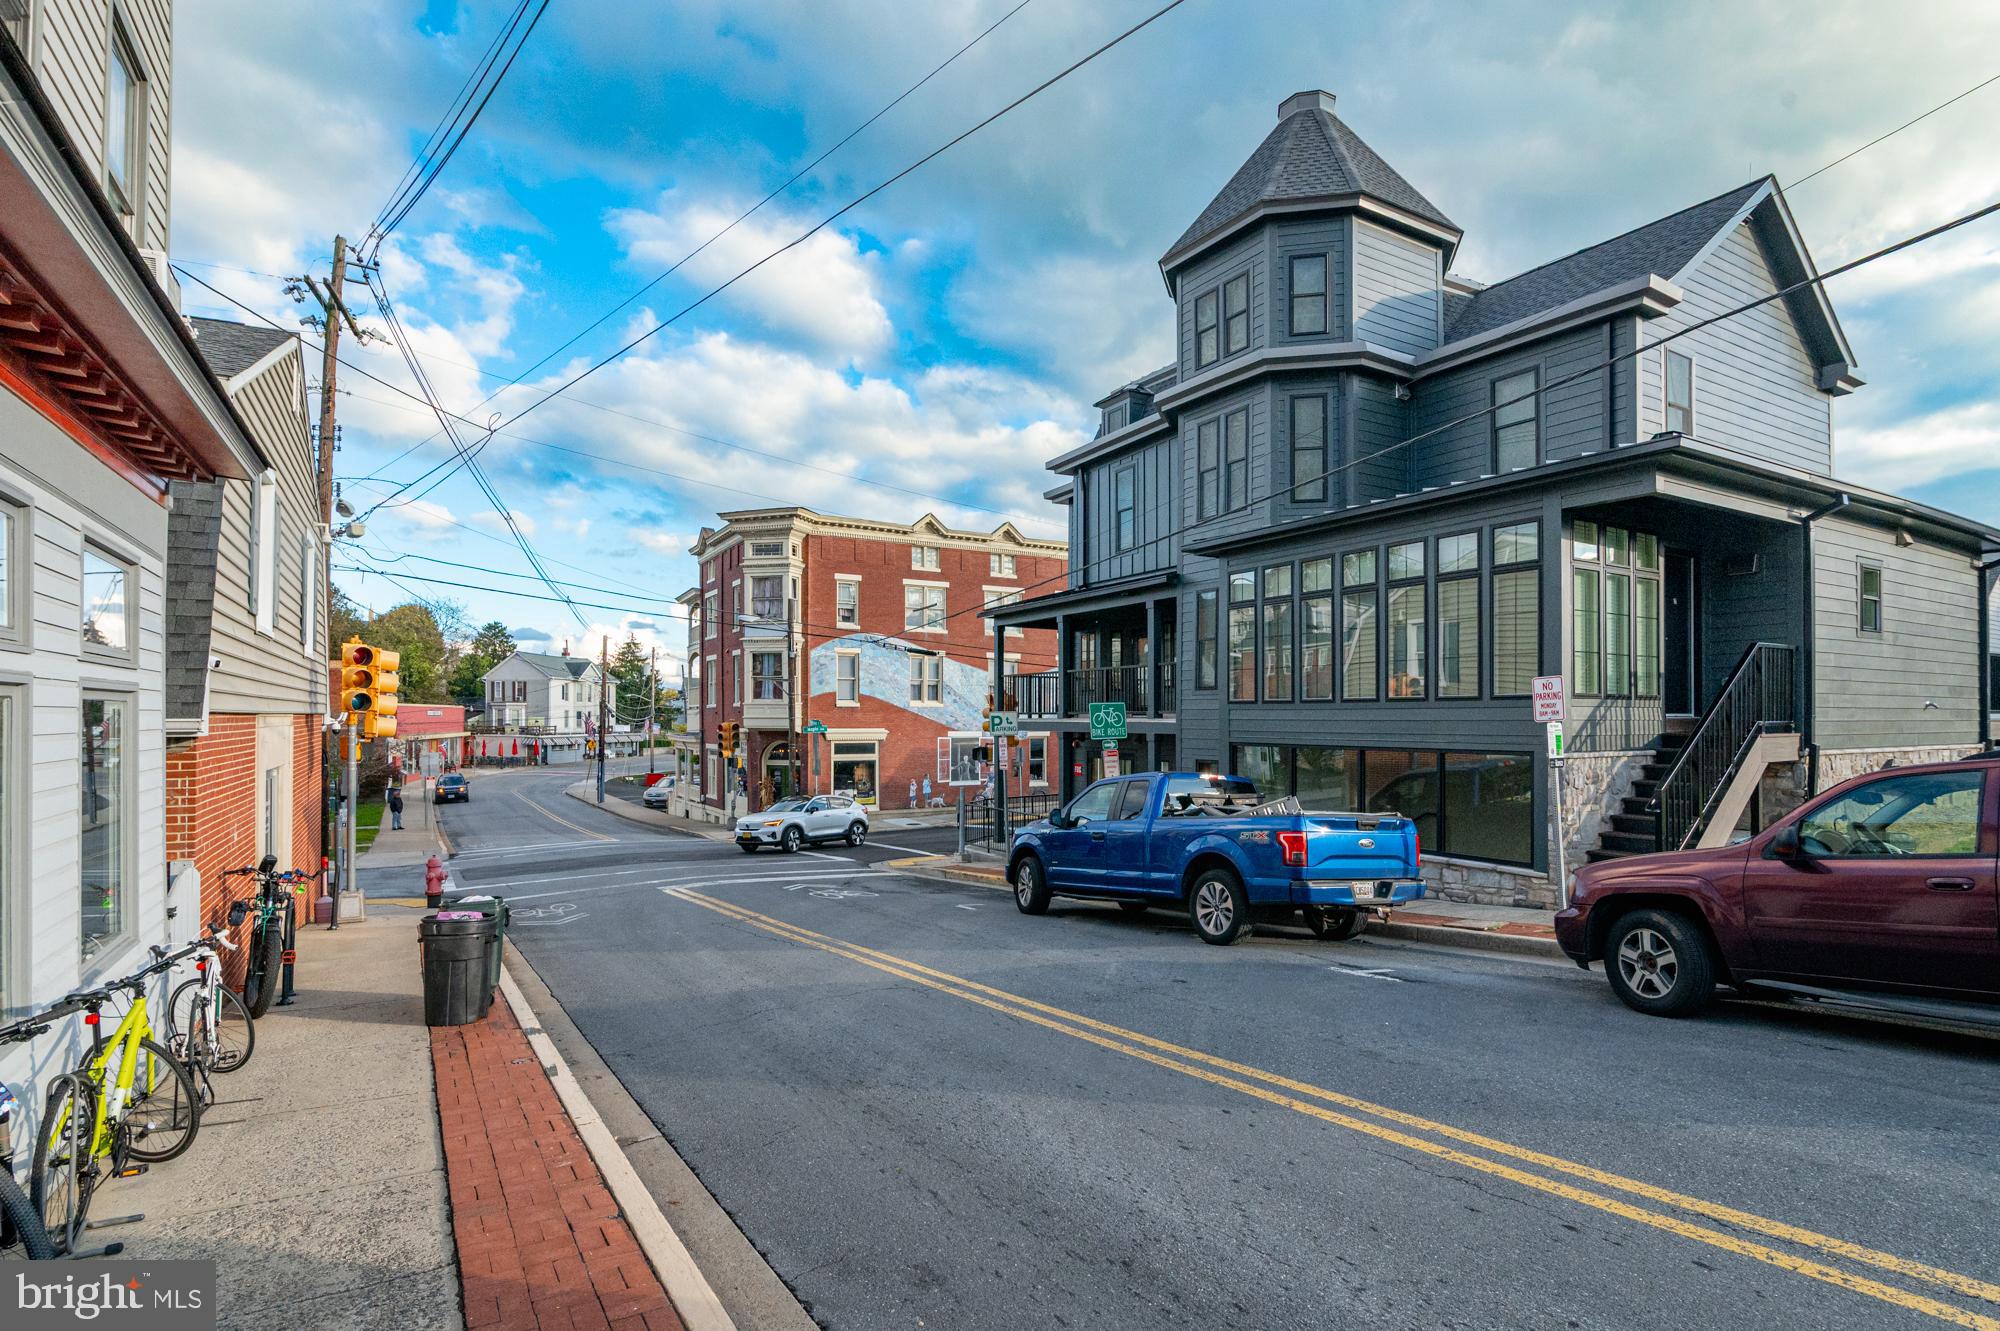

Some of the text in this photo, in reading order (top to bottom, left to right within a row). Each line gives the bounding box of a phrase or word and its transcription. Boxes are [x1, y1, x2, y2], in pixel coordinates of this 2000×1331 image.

[1542, 682, 1553, 691] NO
[1536, 691, 1562, 701] PARKING
[991, 715, 1017, 732] PARKING
[1092, 728, 1126, 736] BIKE ROUTE
[1239, 831, 1270, 841] STX
